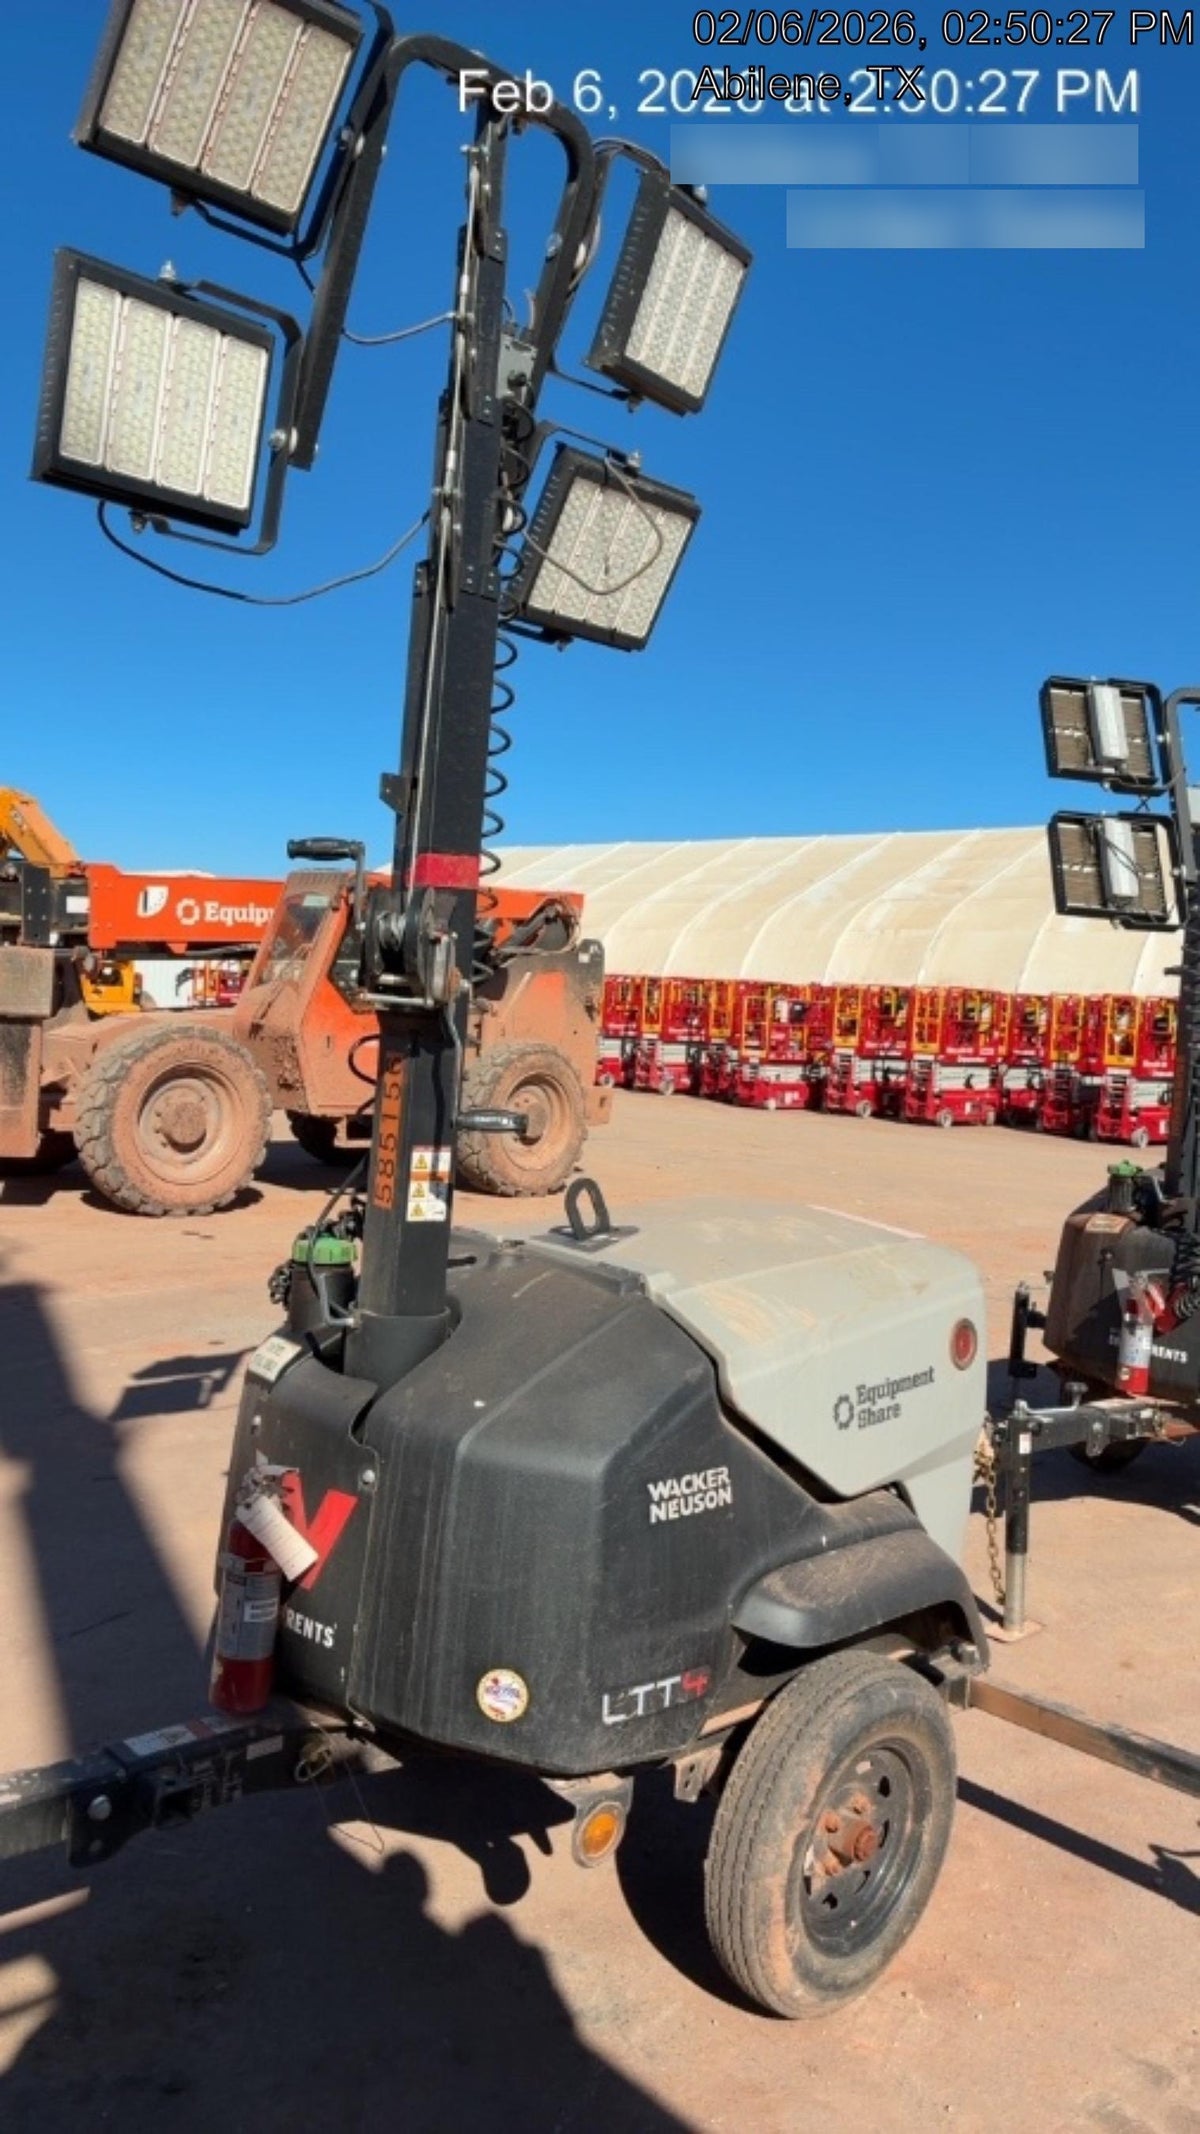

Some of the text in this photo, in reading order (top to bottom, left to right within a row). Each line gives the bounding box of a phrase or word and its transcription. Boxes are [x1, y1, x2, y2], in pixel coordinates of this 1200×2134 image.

[856, 1365, 935, 1406] Equipment
[858, 1402, 901, 1429] Share
[646, 1465, 731, 1502] WACKER
[649, 1485, 732, 1526] NEUSON
